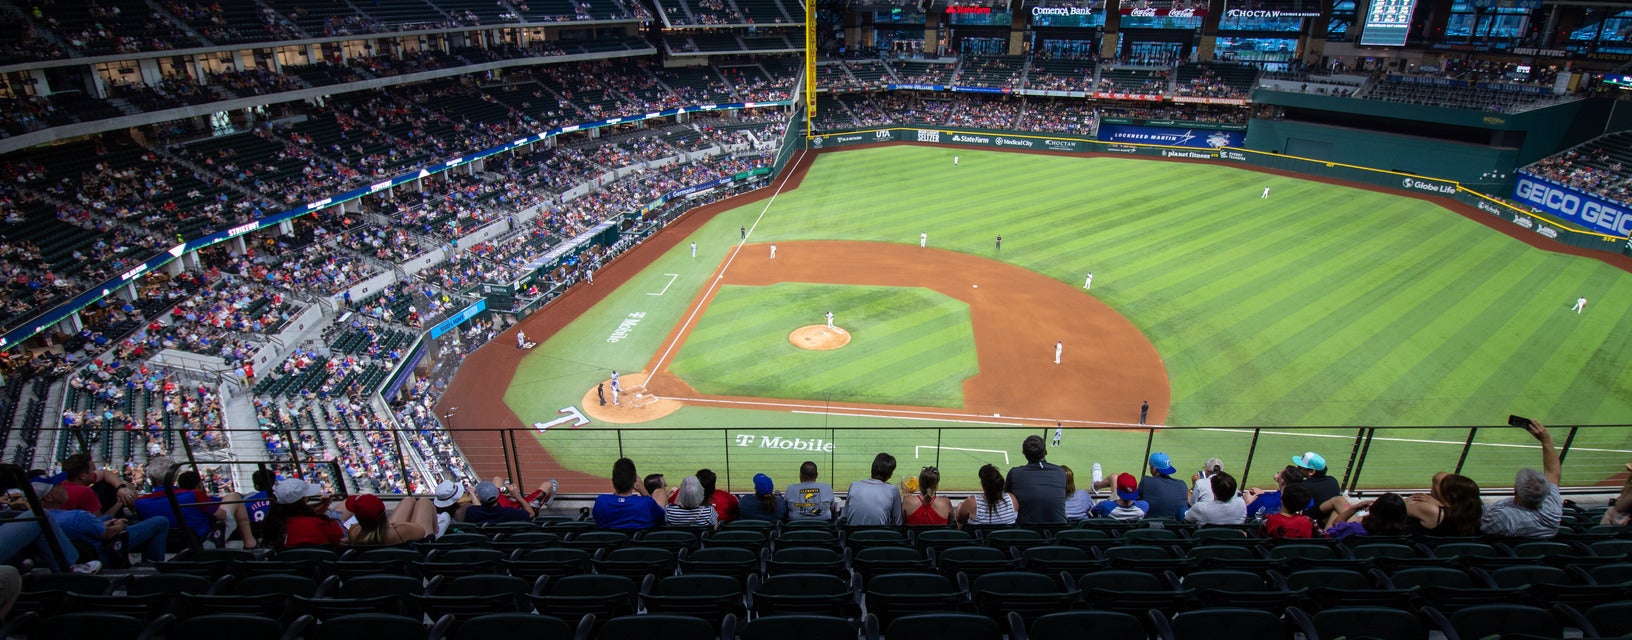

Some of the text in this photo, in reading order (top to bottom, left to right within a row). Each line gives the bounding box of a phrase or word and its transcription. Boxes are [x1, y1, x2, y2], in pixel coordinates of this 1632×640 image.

[1070, 7, 1091, 15] Bank
[1232, 9, 1281, 18] CHOCTAW
[875, 130, 891, 139] UTA
[1189, 152, 1211, 160] fitness
[1414, 180, 1457, 195] Globe Life
[1517, 179, 1580, 216] GEICO
[227, 220, 260, 237] STRIKEOUT
[759, 435, 836, 453] Mobile
